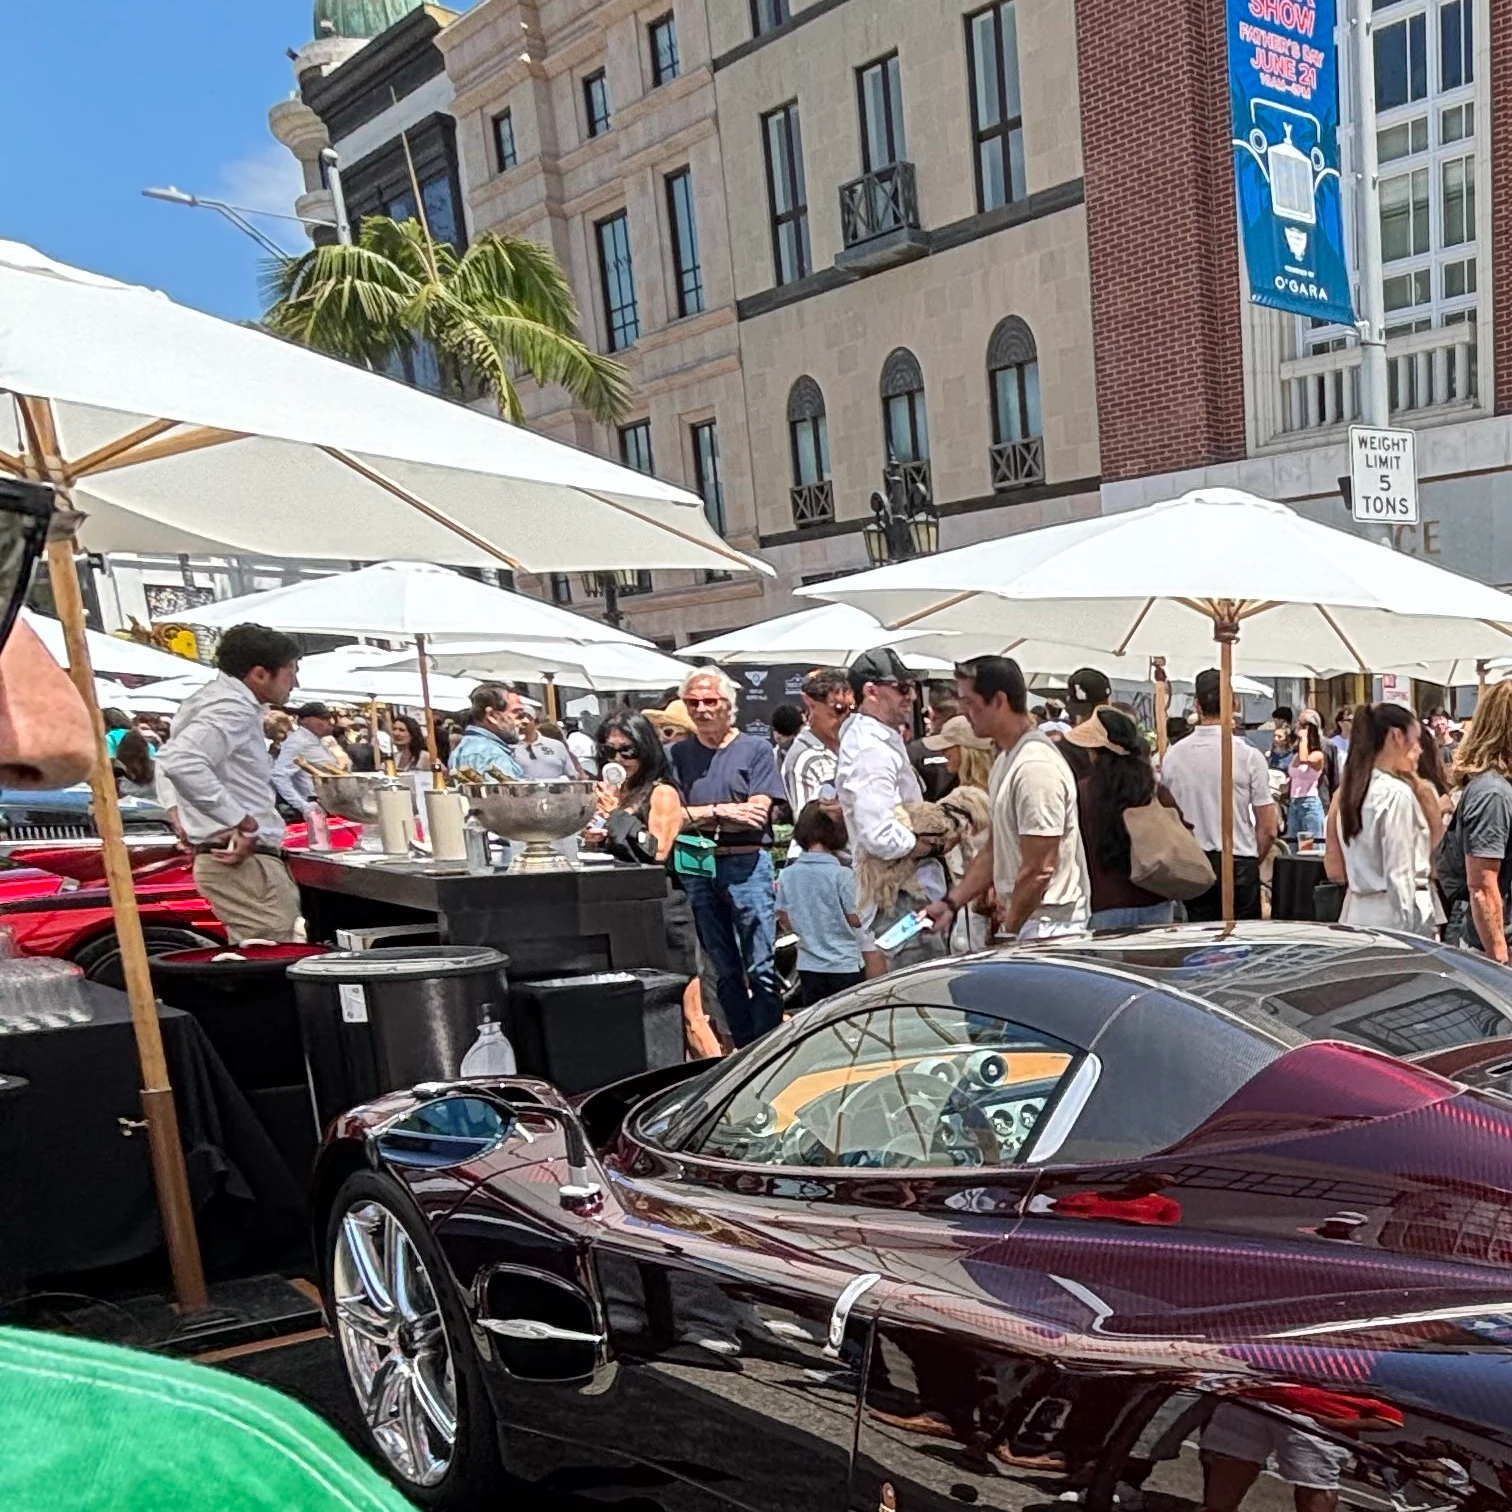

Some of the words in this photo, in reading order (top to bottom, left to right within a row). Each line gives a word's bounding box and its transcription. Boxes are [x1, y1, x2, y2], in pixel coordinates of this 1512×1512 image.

[1239, 20, 1300, 59] FATHER'S
[1250, 46, 1297, 81] JUNE
[1298, 62, 1317, 90] 21
[1274, 275, 1329, 301] O'GARA
[1358, 435, 1408, 452] WEIGHT
[1365, 453, 1401, 470] LIMIT
[1379, 474, 1392, 491] 5
[1361, 495, 1409, 515] TONS
